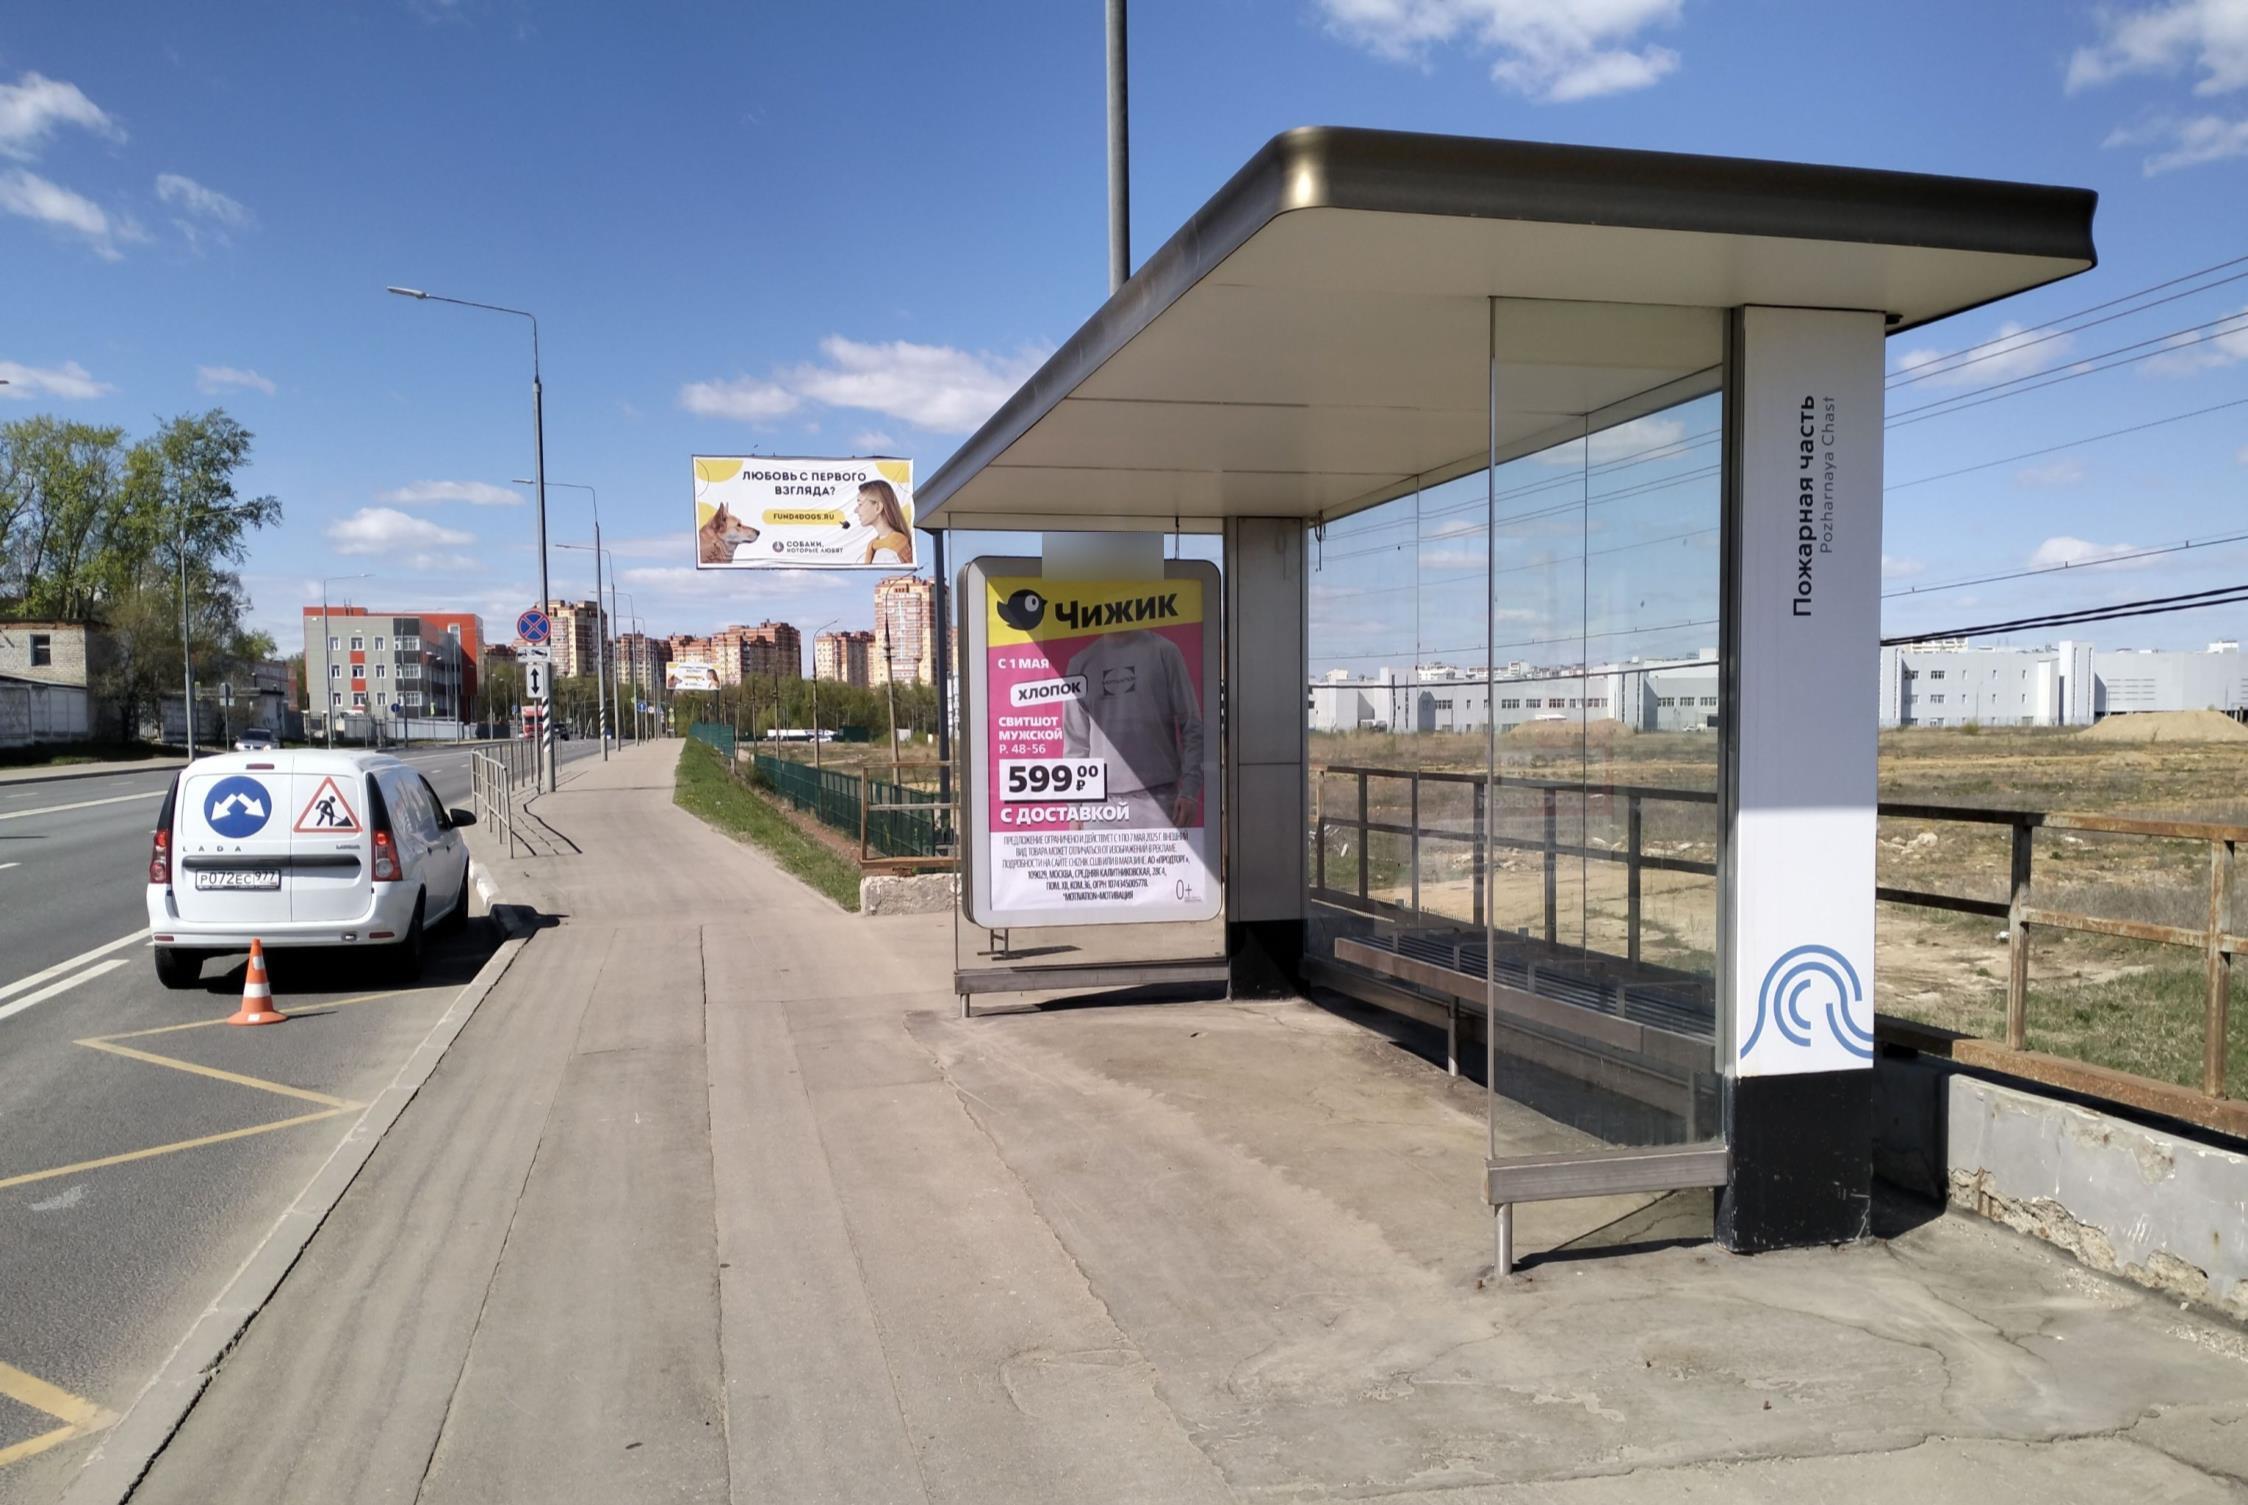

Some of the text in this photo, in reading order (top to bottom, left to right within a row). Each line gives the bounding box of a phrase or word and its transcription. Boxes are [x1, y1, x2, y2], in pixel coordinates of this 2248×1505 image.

[742, 471, 867, 482] ЛЮБОВЬ С ПЕРВОГО
[1820, 396, 1837, 553] Pozharnaya Chast
[775, 485, 836, 497] ВЗГЛЯДА?
[1793, 395, 1817, 616] Пожарная часть
[998, 658, 1050, 669] С 1 МАЯ
[1018, 682, 1081, 700] ХЛОПОК
[998, 716, 1059, 727] СВИТШОТ
[998, 728, 1063, 740] МУЖСКОЙ
[999, 744, 1046, 754] Р. 48-56
[1008, 765, 1073, 793] 599
[1000, 801, 1130, 825] С ДОСТАВКОЙ
[1176, 879, 1193, 900] 0+
